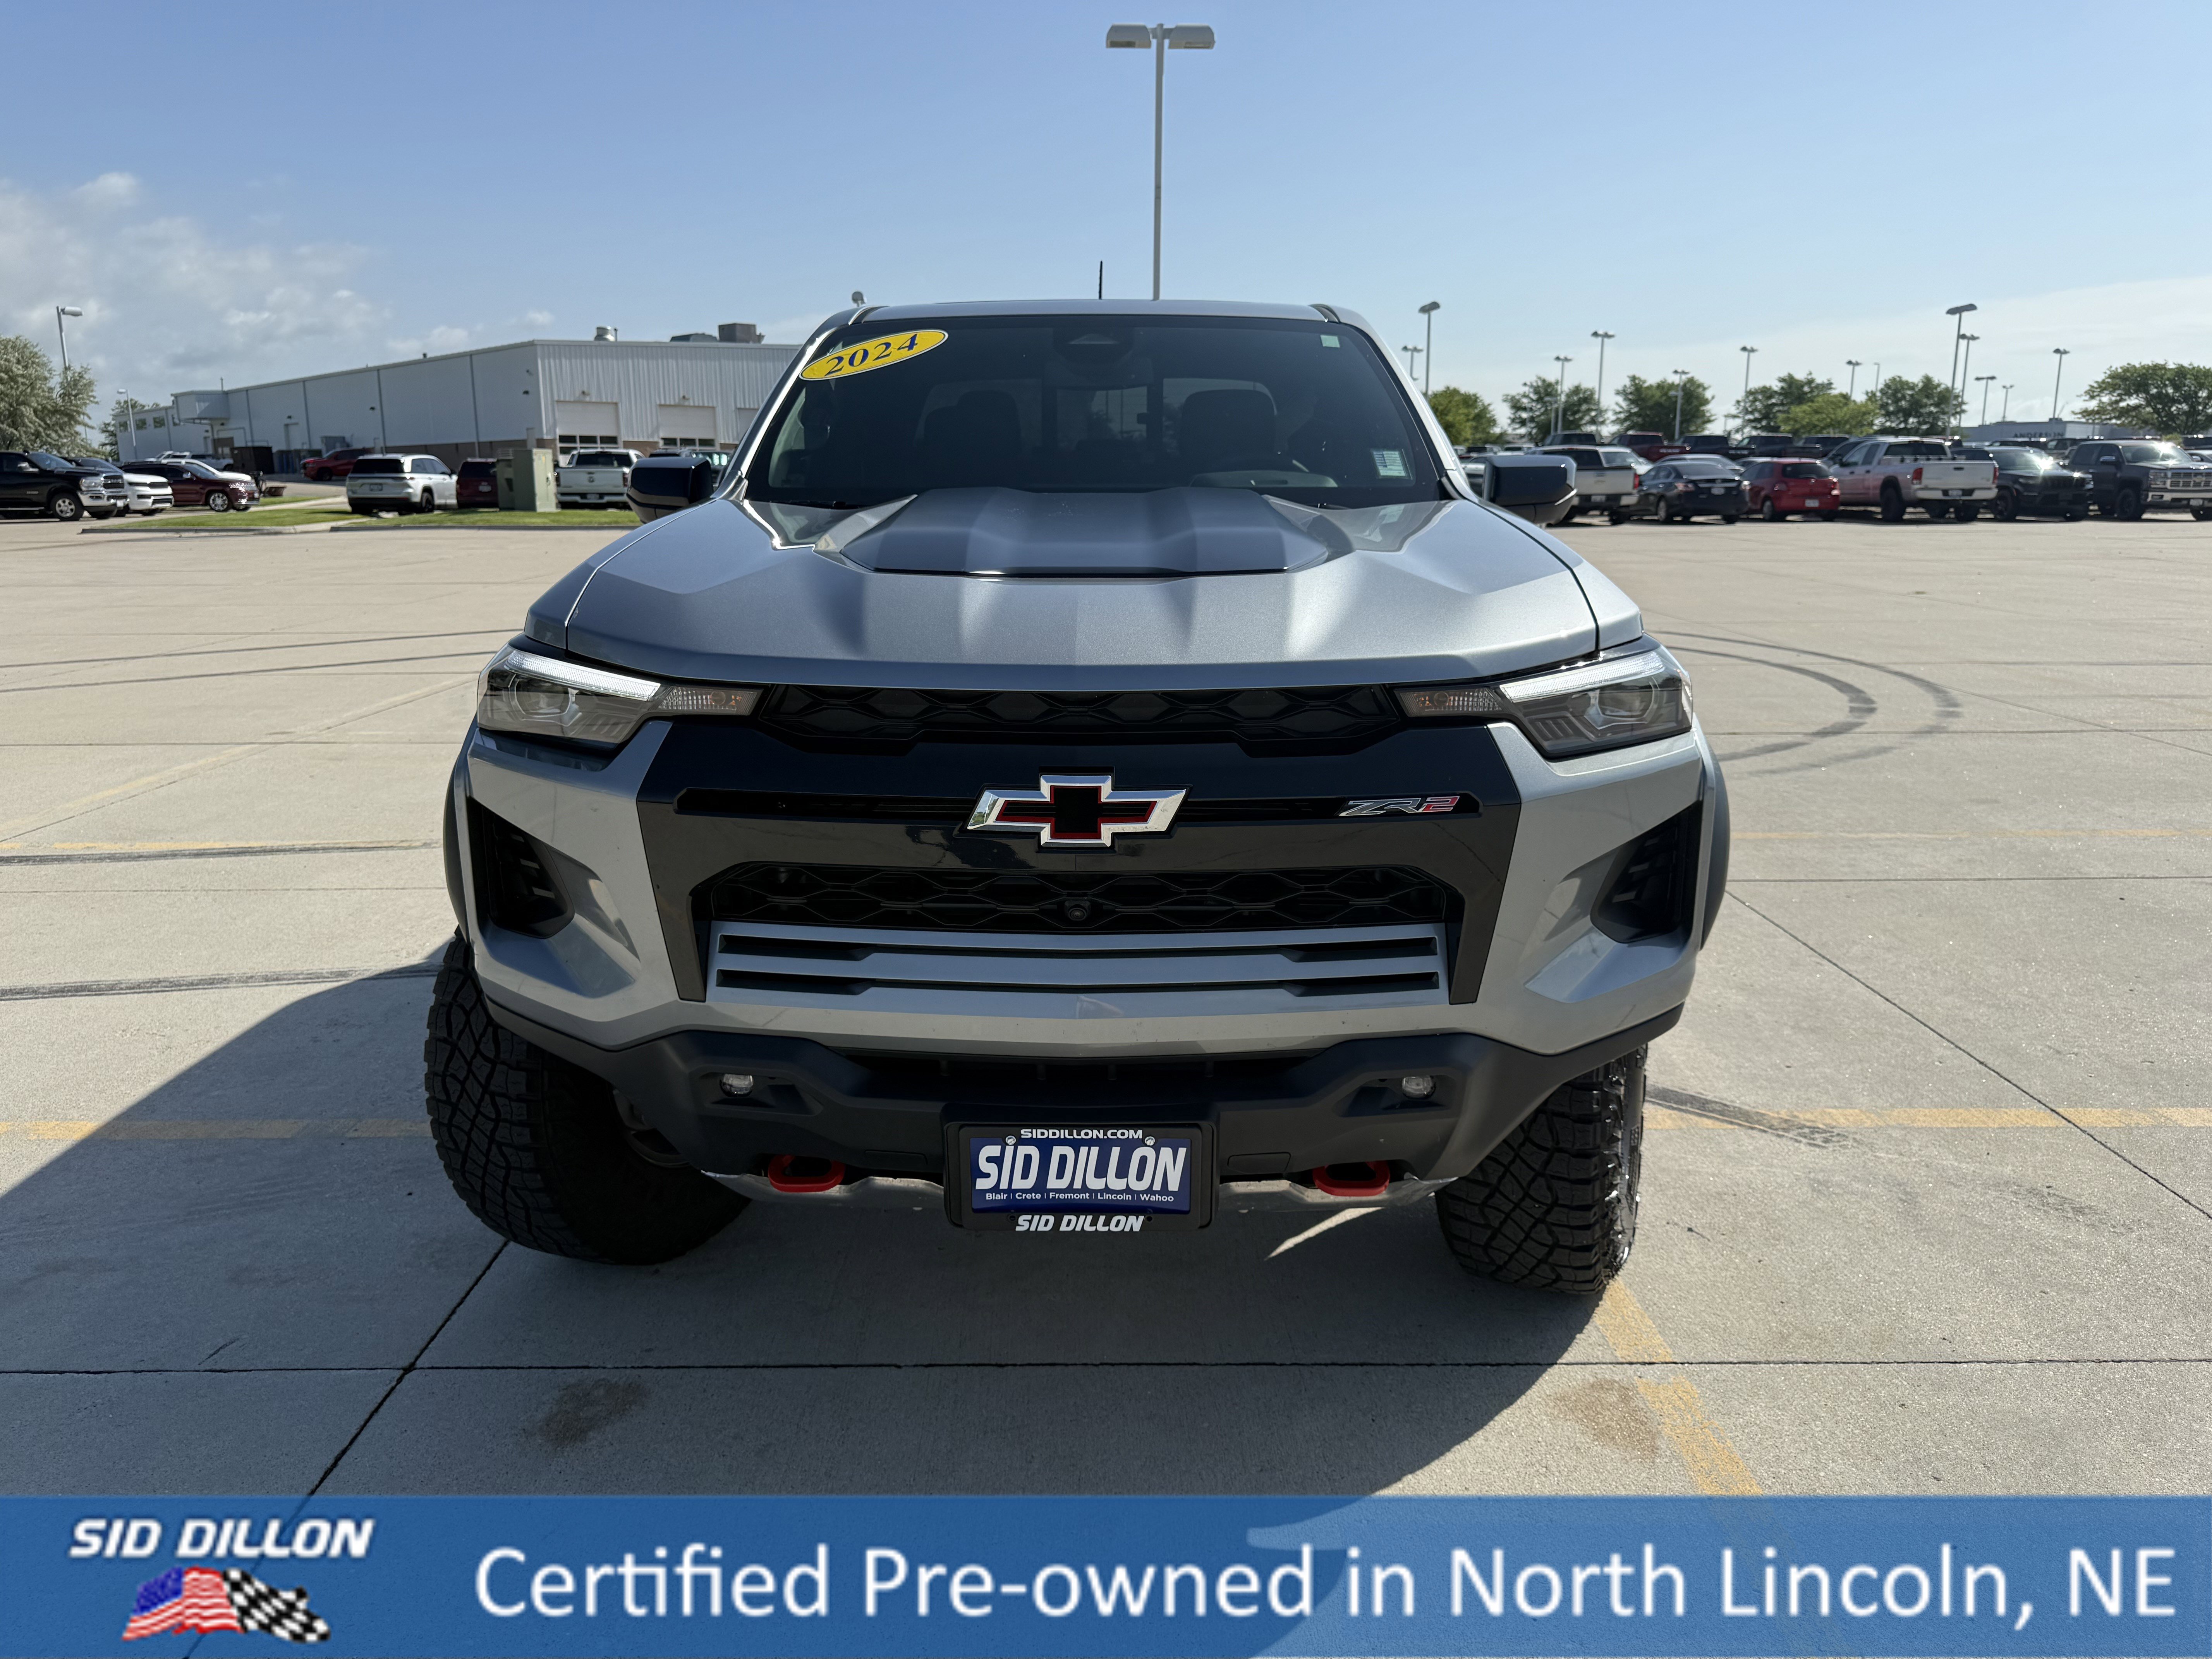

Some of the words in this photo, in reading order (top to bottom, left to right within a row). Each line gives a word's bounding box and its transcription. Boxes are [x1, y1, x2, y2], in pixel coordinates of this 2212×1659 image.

[824, 333, 918, 377] 2024
[1339, 796, 1460, 816] ZR2
[1020, 1129, 1142, 1139] SIDDILLON.COM
[975, 1145, 1040, 1190] SID
[1046, 1146, 1187, 1191] DILLON
[1097, 1192, 1132, 1200] Lincoln
[1140, 1194, 1174, 1202] Wahoo
[1015, 1215, 1054, 1231] SID
[1059, 1215, 1144, 1231] DILLON
